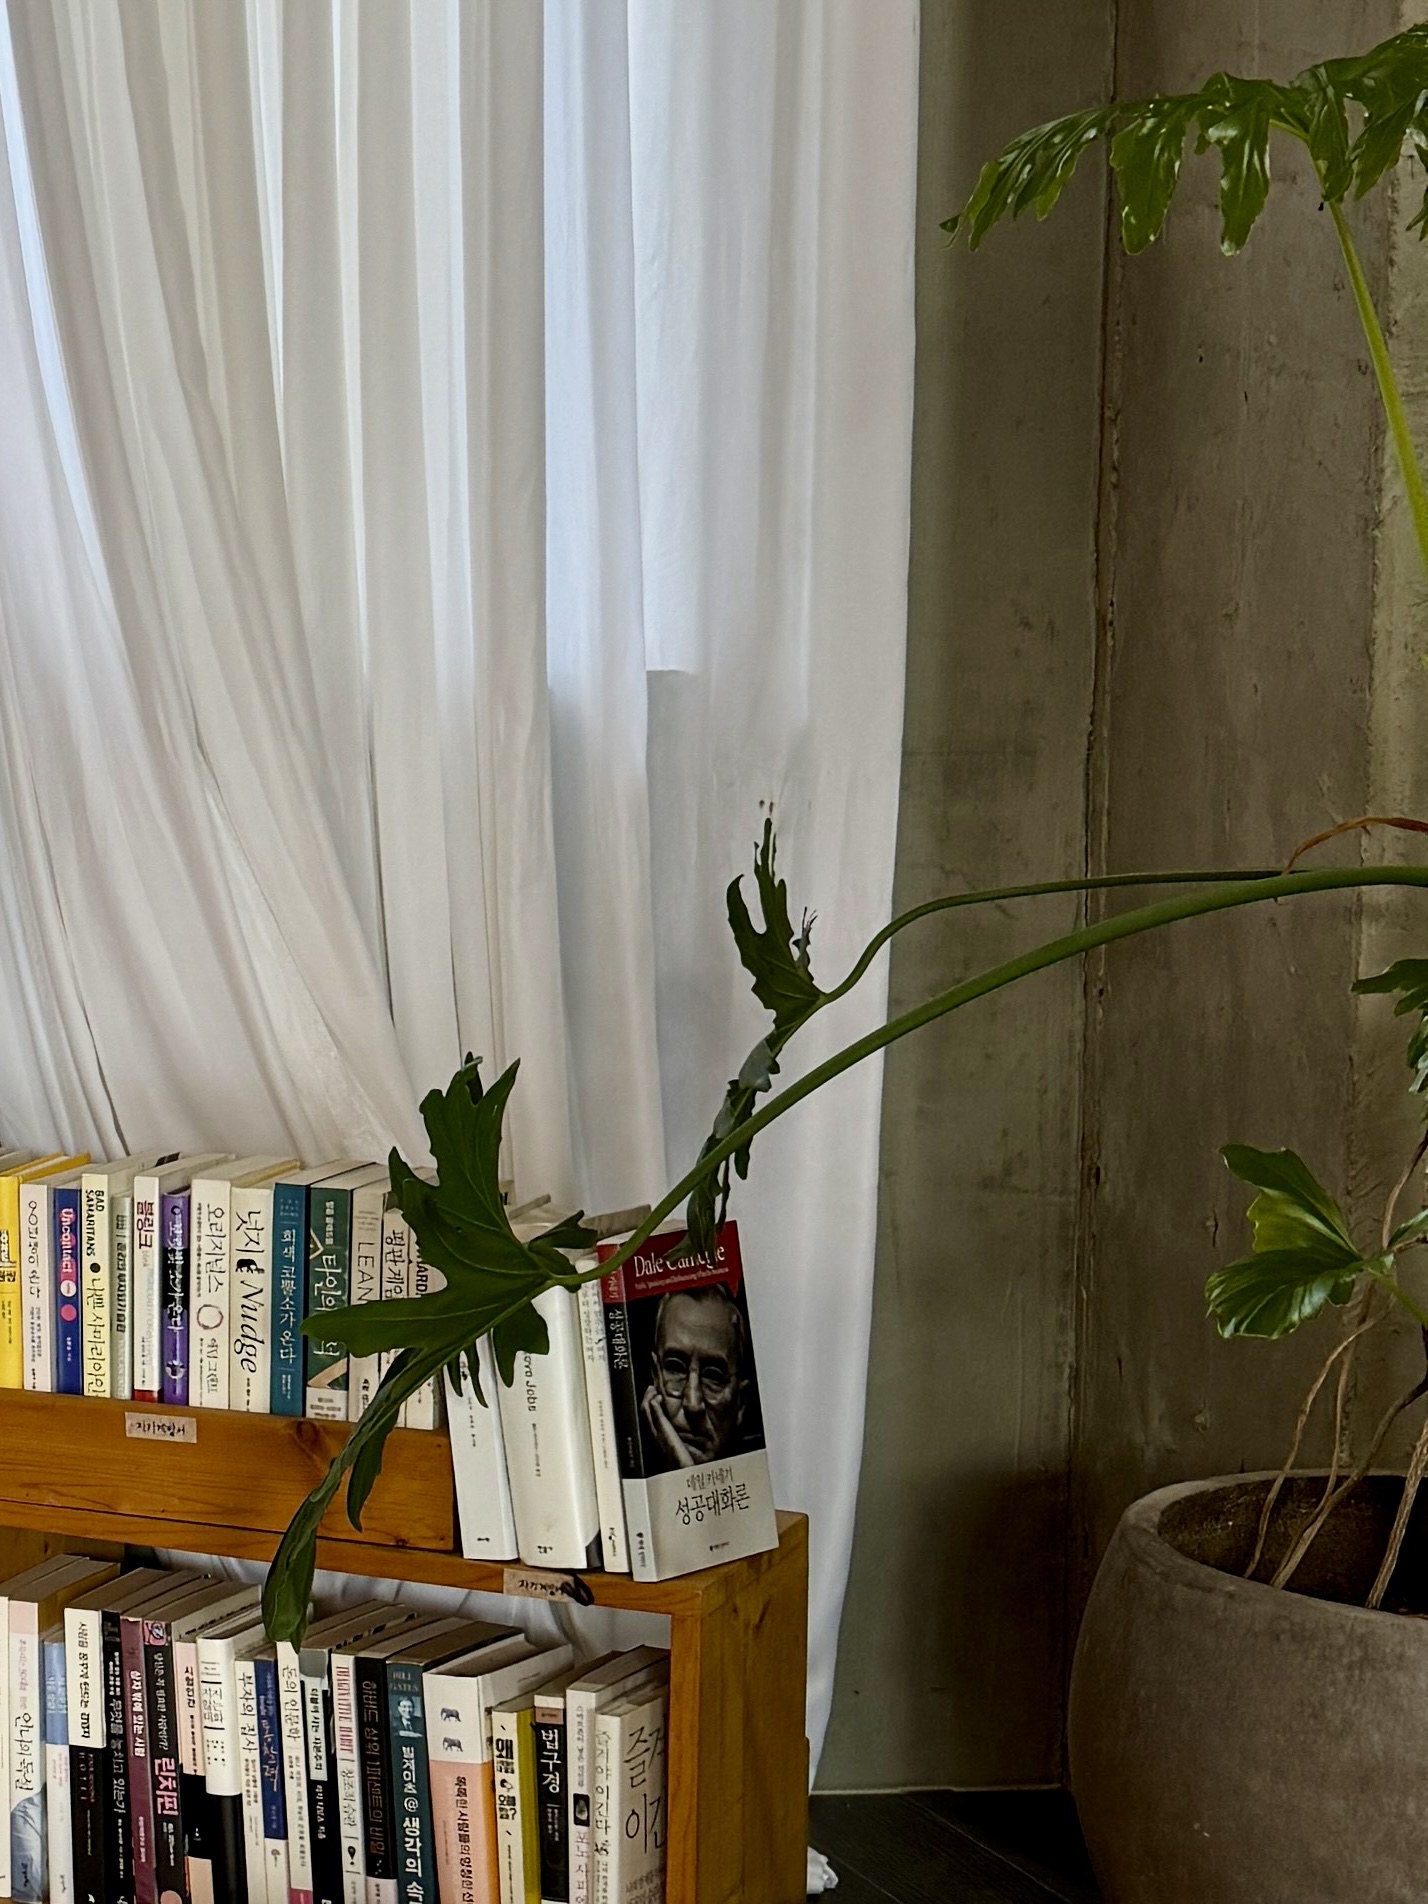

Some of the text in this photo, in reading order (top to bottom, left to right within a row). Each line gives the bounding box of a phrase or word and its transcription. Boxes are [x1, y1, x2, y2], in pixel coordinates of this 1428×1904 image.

[85, 1189, 95, 1256] SAMARITANS
[95, 1190, 105, 1212] BAD
[60, 1208, 74, 1273] Uncontact
[137, 1200, 155, 1250] 블링크
[235, 1211, 265, 1254] 넛지
[281, 1229, 295, 1262] 회색
[205, 1203, 226, 1294] 오리지널스
[386, 1230, 404, 1266] 평판
[633, 1252, 663, 1278] Dale
[314, 1255, 341, 1311] 타인의
[234, 1280, 265, 1374] Nudge
[280, 1331, 295, 1364] 온다
[675, 1483, 751, 1525] 성공대화론
[282, 1664, 298, 1694] 돈의
[361, 1680, 378, 1722] 하버드
[239, 1671, 259, 1753] 부자의 집사
[284, 1699, 300, 1742] 인문학
[336, 1665, 354, 1754] IMAGINATIVE HABIT
[14, 1712, 34, 1791] 언니의 독설
[540, 1729, 561, 1795] 법구경
[153, 1757, 178, 1816] 린치핀
[454, 1776, 469, 1809] 똑똑한
[402, 1816, 423, 1876] 생각의
[457, 1810, 472, 1855] 사람들의
[459, 1856, 474, 1890] 멍청한
